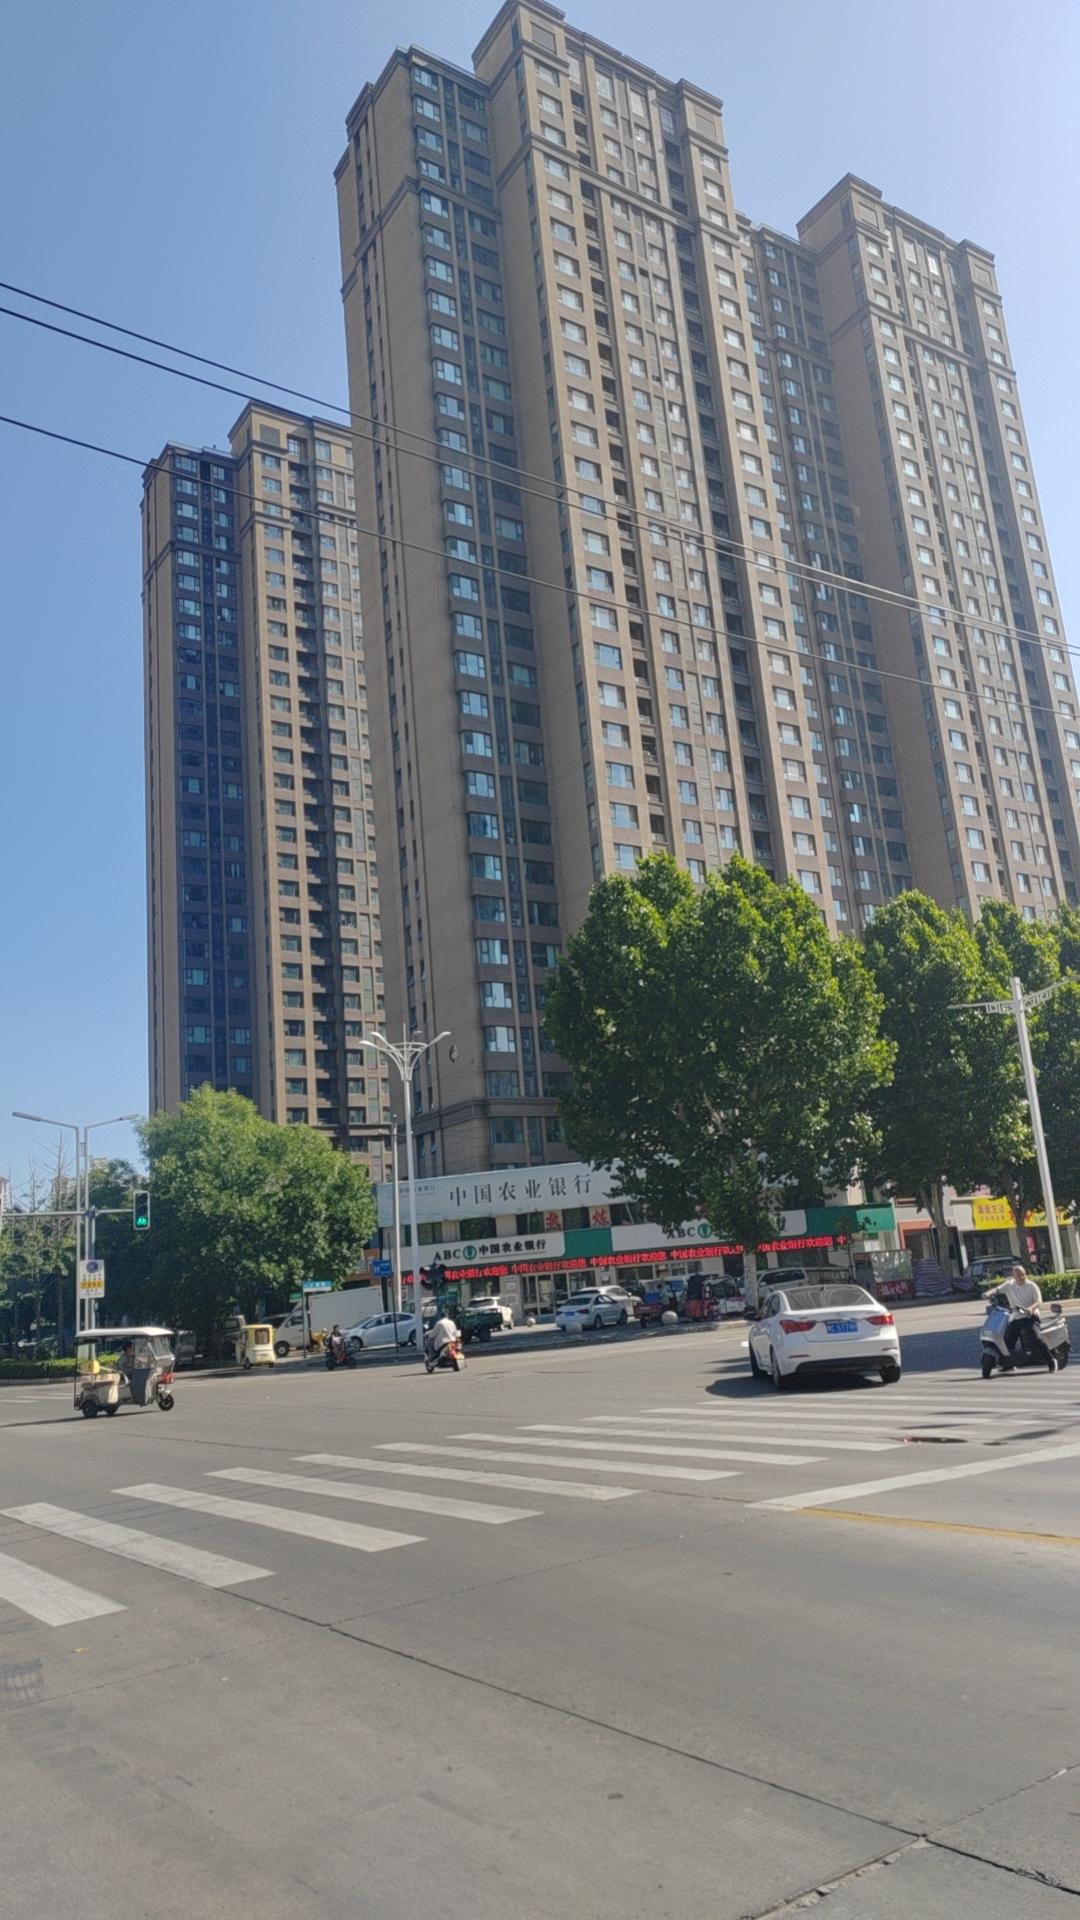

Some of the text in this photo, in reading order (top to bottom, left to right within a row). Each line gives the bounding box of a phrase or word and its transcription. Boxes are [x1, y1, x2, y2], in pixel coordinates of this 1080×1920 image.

[450, 1174, 591, 1206] 中国农业银行
[434, 1249, 461, 1261] ABC
[479, 1239, 545, 1255] 中国农业银行
